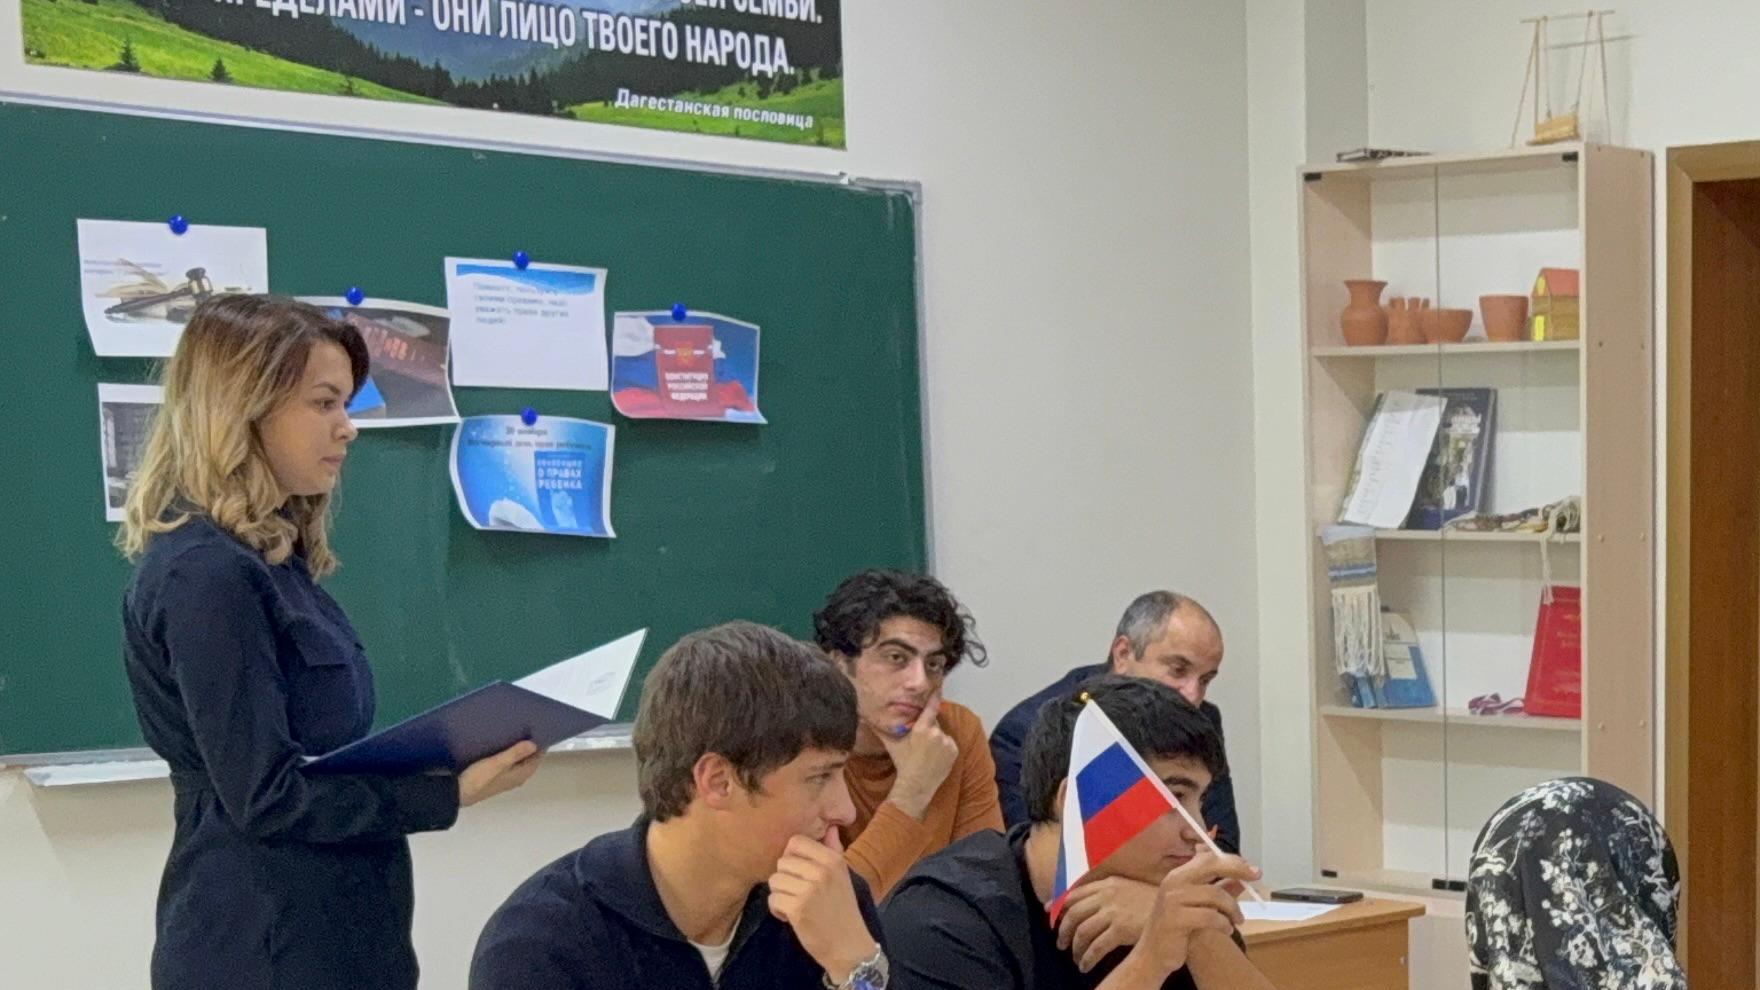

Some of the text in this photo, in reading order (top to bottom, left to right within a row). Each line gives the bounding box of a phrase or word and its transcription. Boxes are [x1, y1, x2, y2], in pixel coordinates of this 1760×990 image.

[431, 0, 491, 35] ОНИ
[500, 1, 576, 49] ЛИЦО
[582, 12, 677, 59] ТВОЕГО
[686, 25, 795, 77] НАРОДА.
[614, 88, 814, 129] Дагестанская пословица
